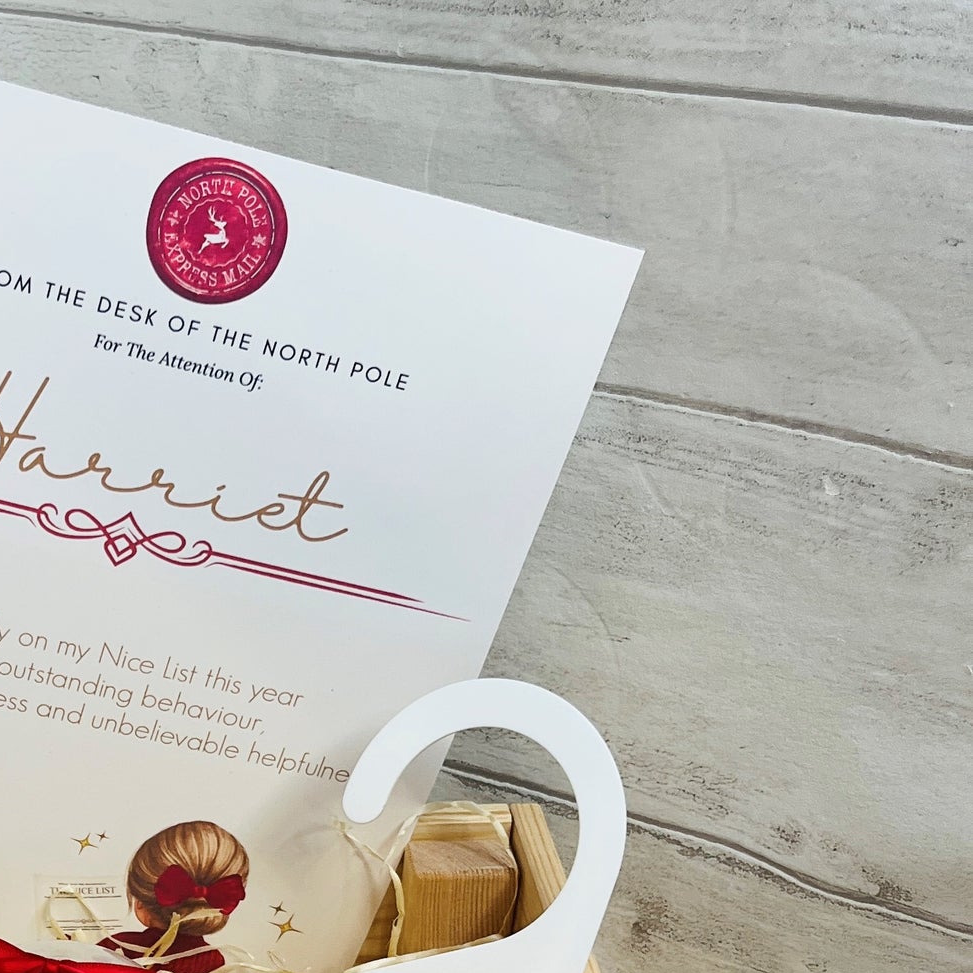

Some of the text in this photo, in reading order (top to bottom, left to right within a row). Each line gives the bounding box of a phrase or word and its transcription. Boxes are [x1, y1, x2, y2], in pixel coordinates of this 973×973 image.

[178, 179, 267, 228] NORTH POLE
[164, 232, 261, 287] EXPRESS MAIL
[46, 281, 86, 308] THE
[97, 296, 157, 326] DESK
[168, 315, 201, 336] OF
[212, 325, 252, 351] THE
[263, 339, 340, 373] NORTH
[350, 362, 409, 391] POLE
[94, 334, 263, 392] For The Attention Of:
[19, 633, 47, 650] on
[58, 640, 95, 661] my
[99, 642, 154, 674] Nice
[163, 656, 197, 684] List
[205, 667, 241, 694] this
[248, 685, 303, 707] year
[141, 684, 264, 735] behaviour,
[37, 703, 85, 724] and
[92, 711, 239, 758] unbelievable
[247, 741, 350, 783] helpfulne
